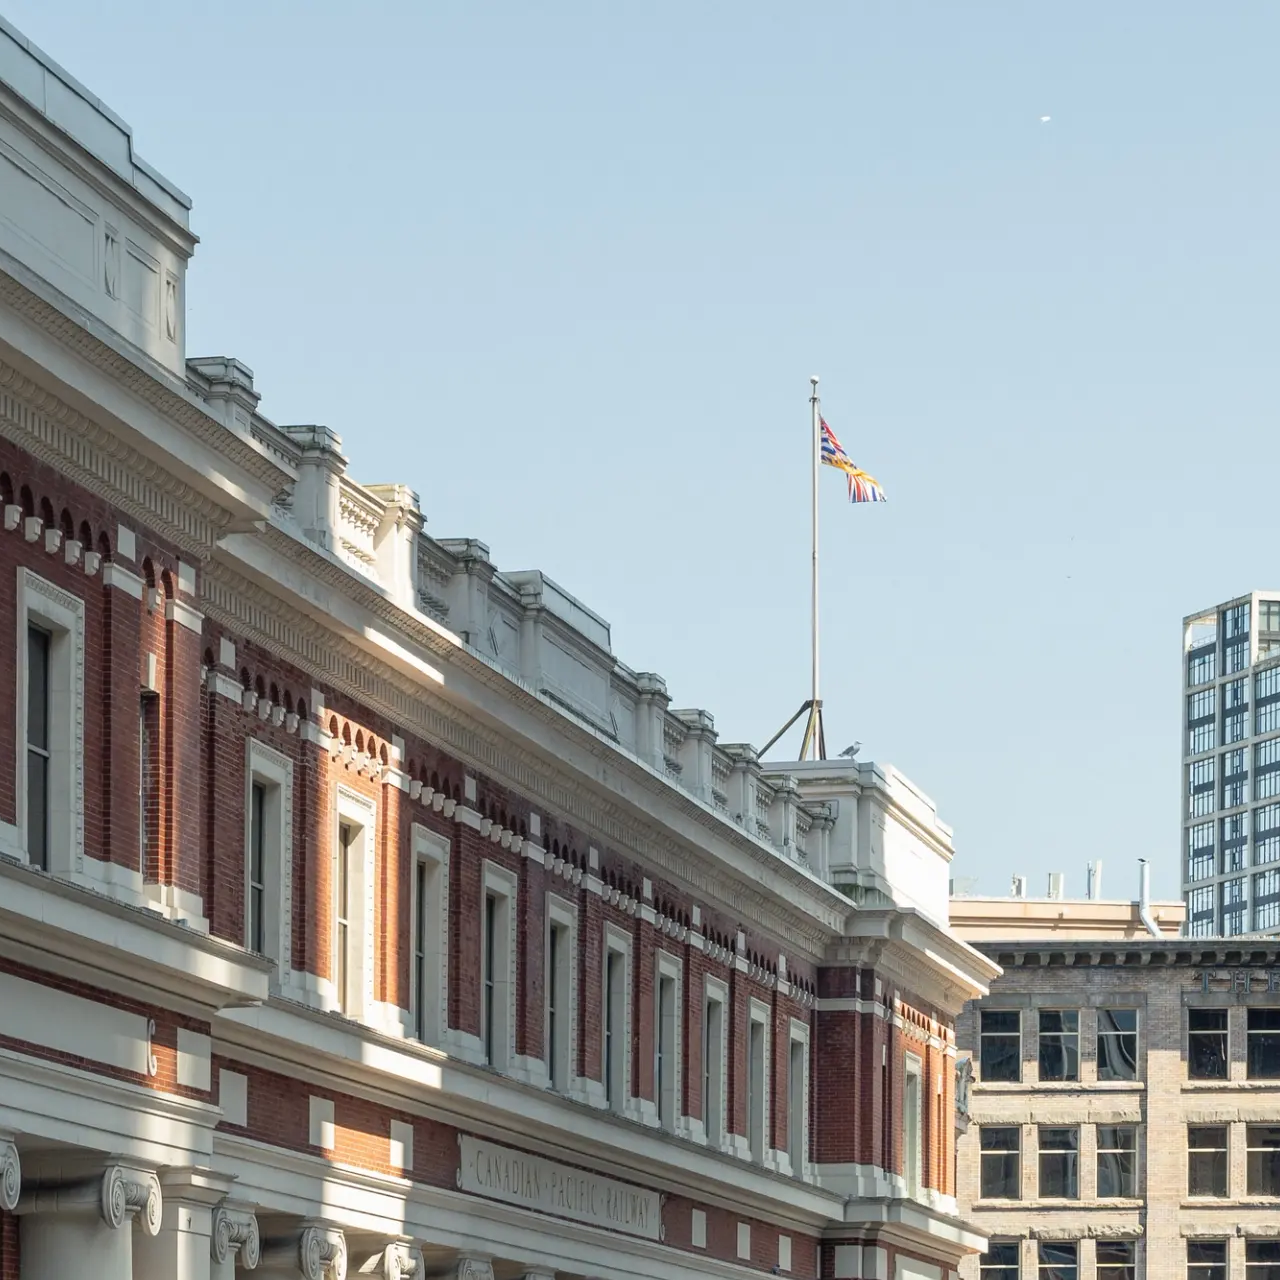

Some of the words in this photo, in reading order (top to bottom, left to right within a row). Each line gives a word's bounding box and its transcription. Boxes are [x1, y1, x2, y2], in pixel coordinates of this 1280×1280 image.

[476, 1150, 540, 1199] CANADIAN
[551, 1172, 597, 1216] PACIFIC
[606, 1187, 650, 1229] RAILWAY
